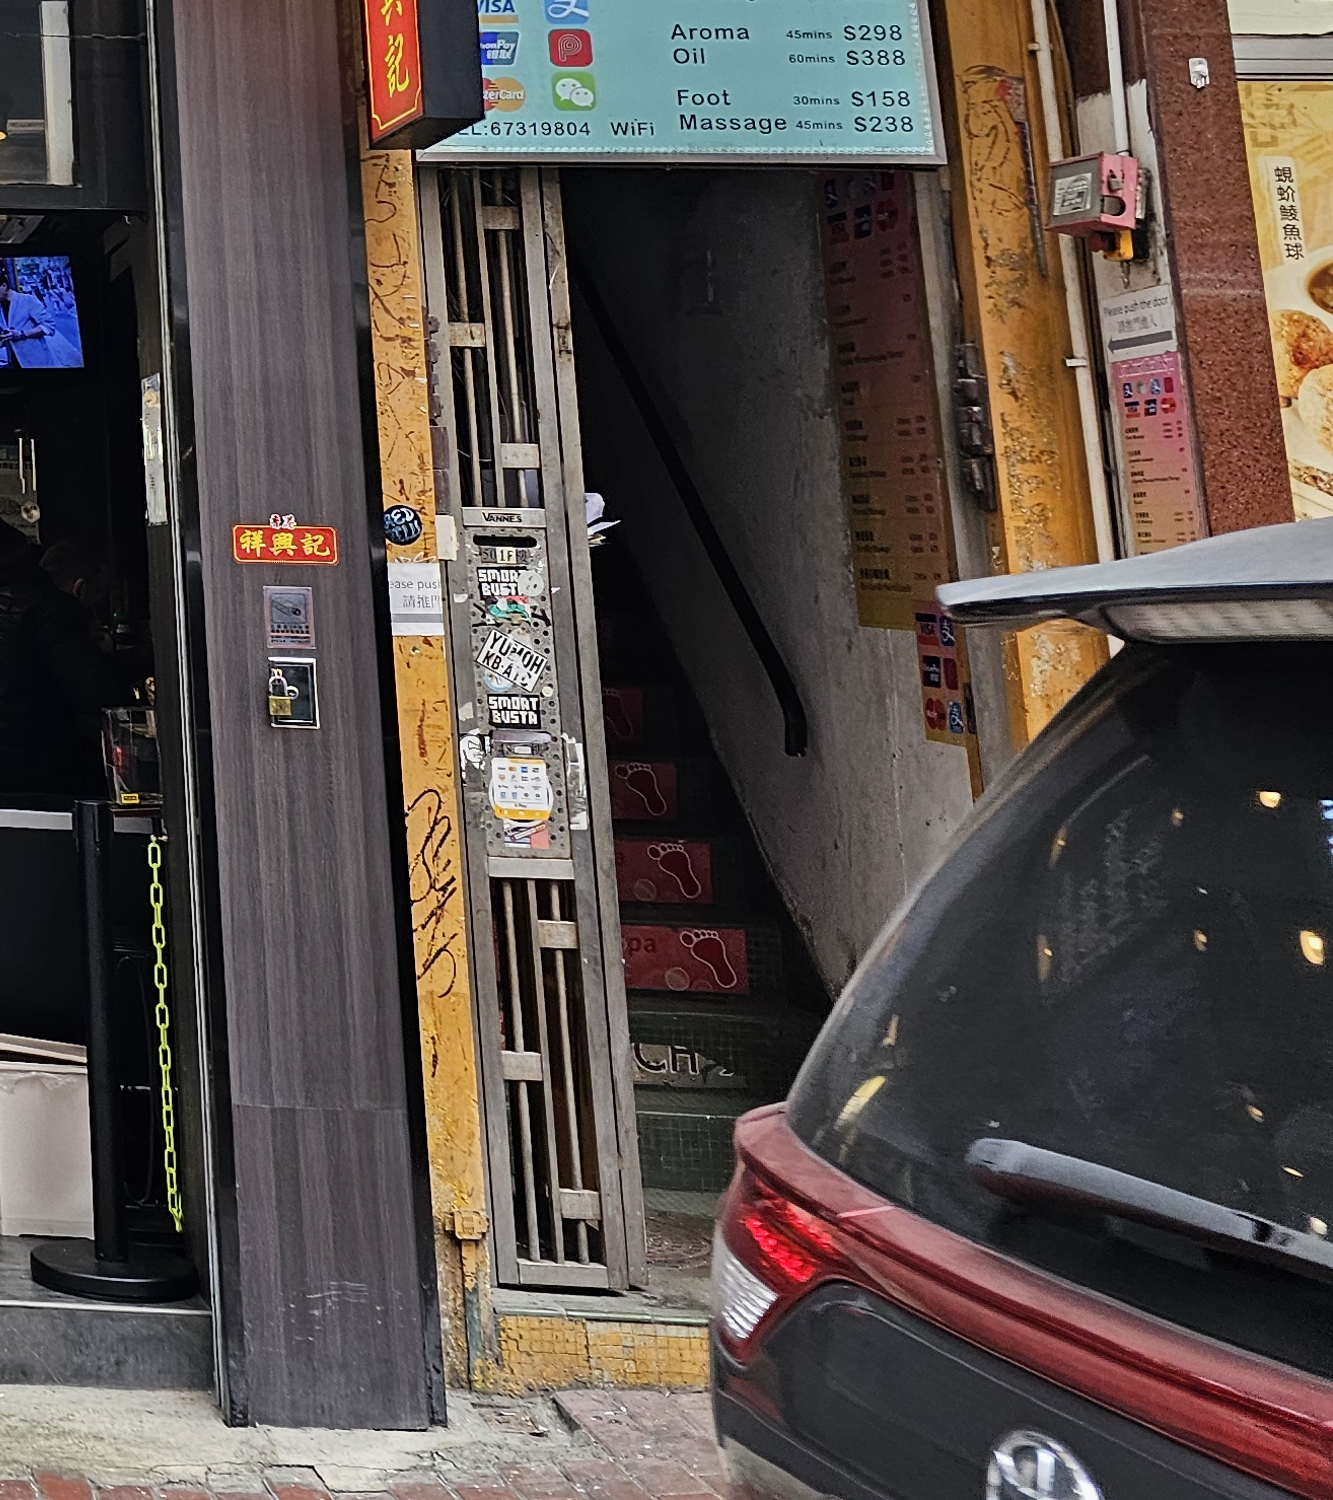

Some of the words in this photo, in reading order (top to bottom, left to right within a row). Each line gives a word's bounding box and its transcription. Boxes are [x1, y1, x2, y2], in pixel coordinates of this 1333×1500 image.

[671, 23, 750, 41] Aroma
[786, 29, 833, 40] 45mins
[843, 24, 903, 42] $298
[674, 47, 706, 65] Oil
[788, 53, 835, 65] 60mins
[846, 49, 906, 67] $388
[677, 88, 731, 106] Foot
[793, 94, 840, 106] 30mins
[851, 89, 911, 107] $158
[459, 121, 590, 136] L:67319804
[610, 120, 654, 136] WiFi
[679, 114, 787, 134] Massage
[795, 118, 843, 131] 45mins
[854, 115, 913, 134] $238
[1274, 166, 1304, 261] 蜆蚧鯪魚球
[482, 512, 523, 523] VANNES
[239, 530, 331, 557] 祥興記
[499, 550, 515, 562] 1F
[389, 580, 414, 590] ease
[417, 579, 440, 591] pus
